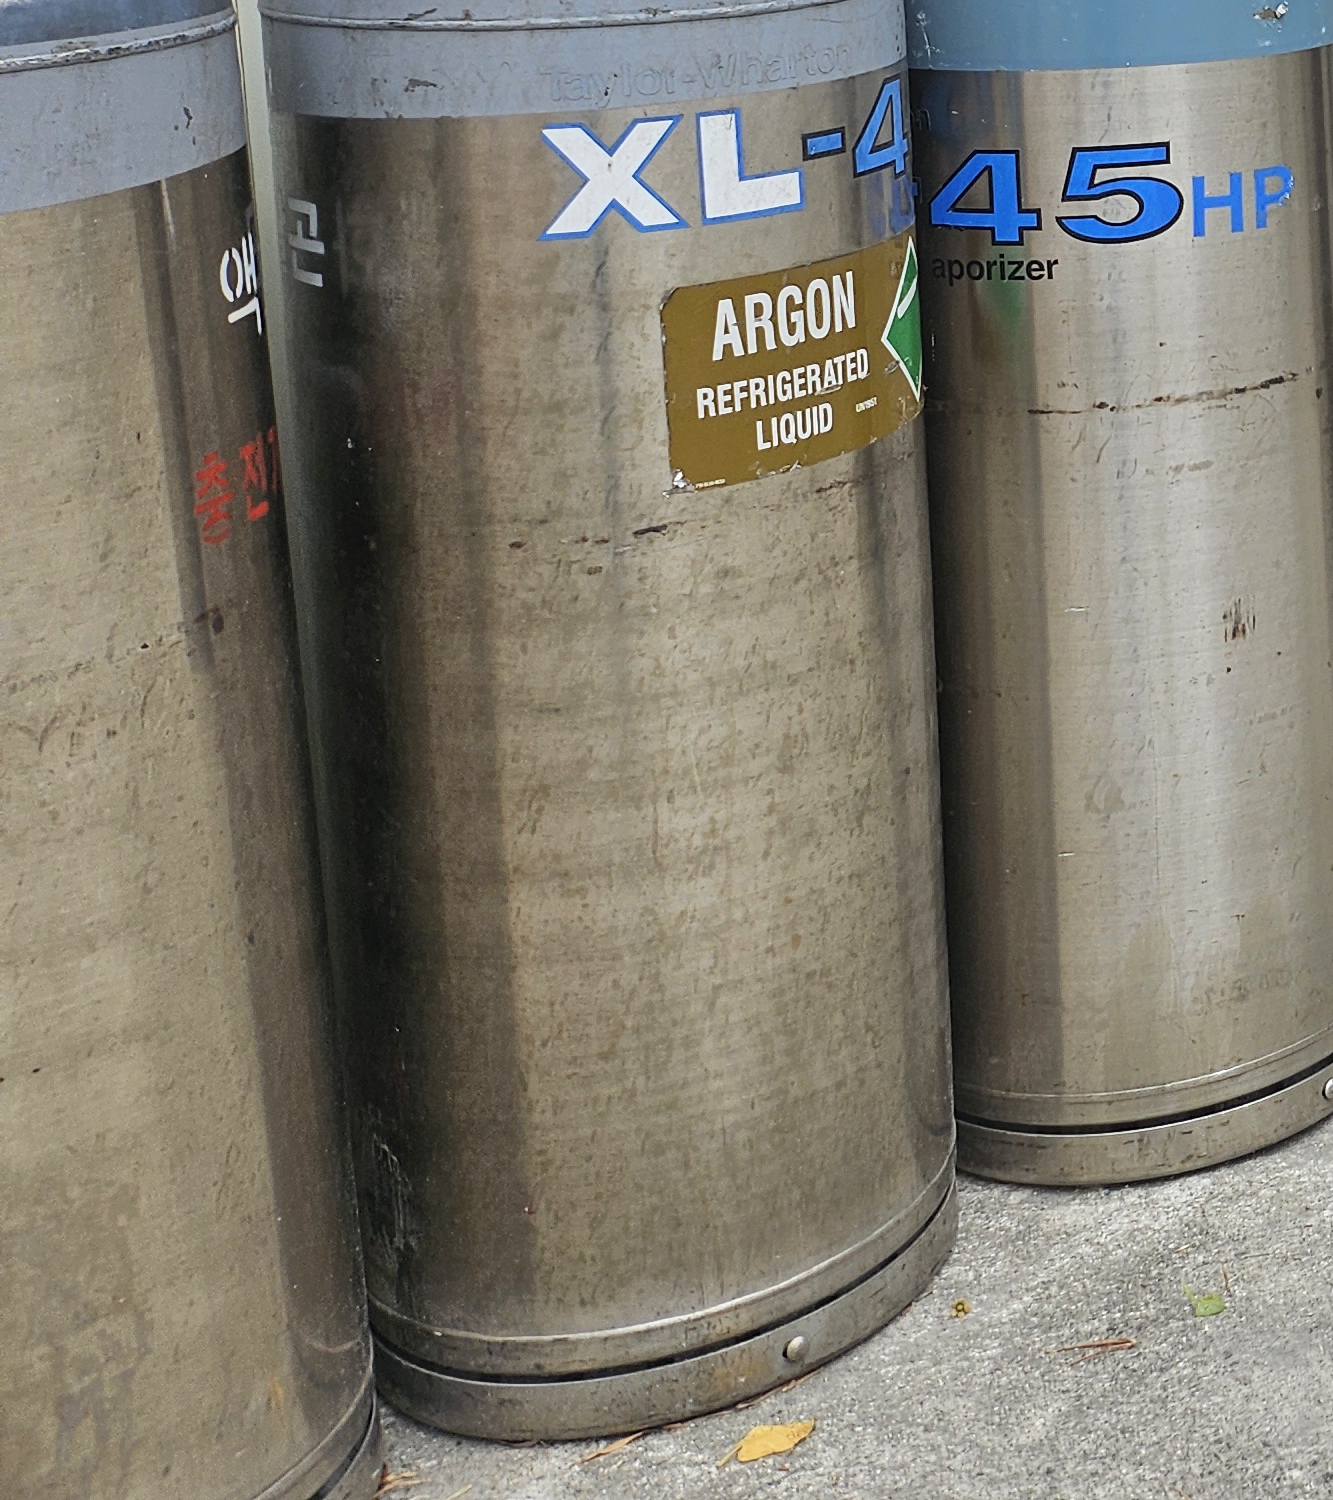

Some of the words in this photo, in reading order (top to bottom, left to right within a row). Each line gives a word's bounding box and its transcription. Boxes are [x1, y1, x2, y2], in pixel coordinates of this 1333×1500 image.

[712, 270, 856, 361] ARGON
[696, 348, 870, 419] REFRIGERATED
[756, 402, 833, 450] LIQUID
